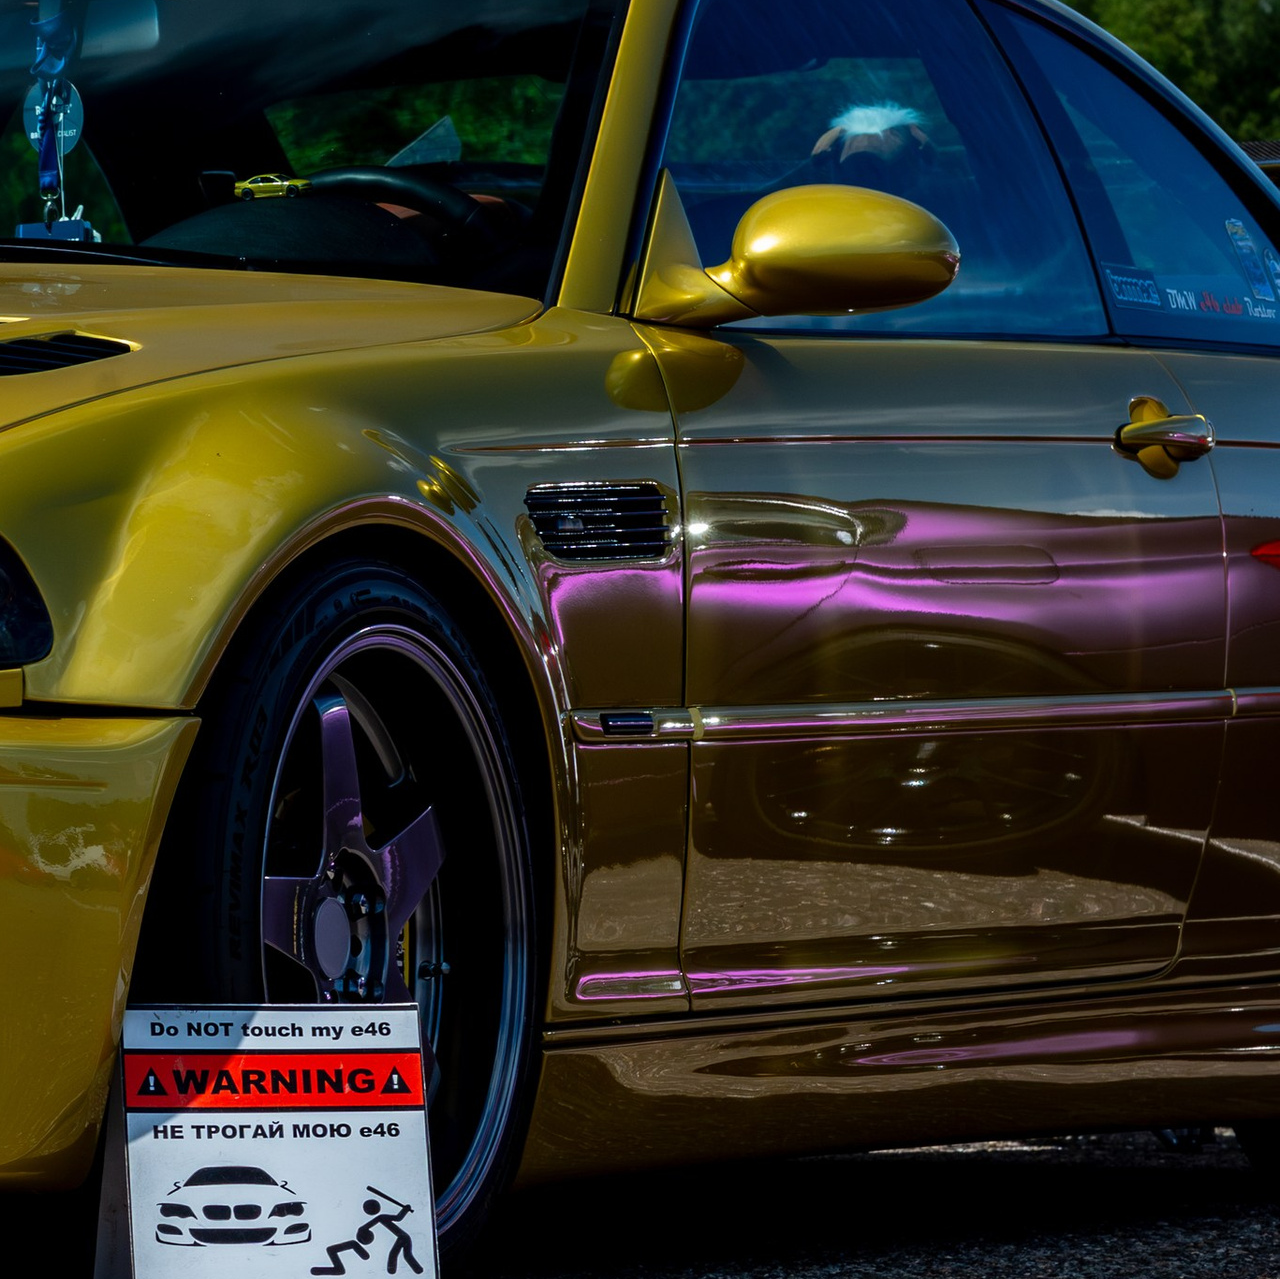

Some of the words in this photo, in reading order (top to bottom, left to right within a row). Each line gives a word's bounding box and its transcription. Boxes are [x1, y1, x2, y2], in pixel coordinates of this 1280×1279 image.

[150, 1022, 179, 1037] Do
[187, 1022, 234, 1037] NOT
[241, 1022, 304, 1037] touch
[311, 1025, 344, 1040] my
[351, 1022, 391, 1037] e46
[172, 1069, 376, 1095] WARNING
[152, 1124, 184, 1140] НЕ
[191, 1121, 285, 1139] ТРОГАЙ
[293, 1123, 352, 1139] МОЮ
[359, 1123, 400, 1138] e46
